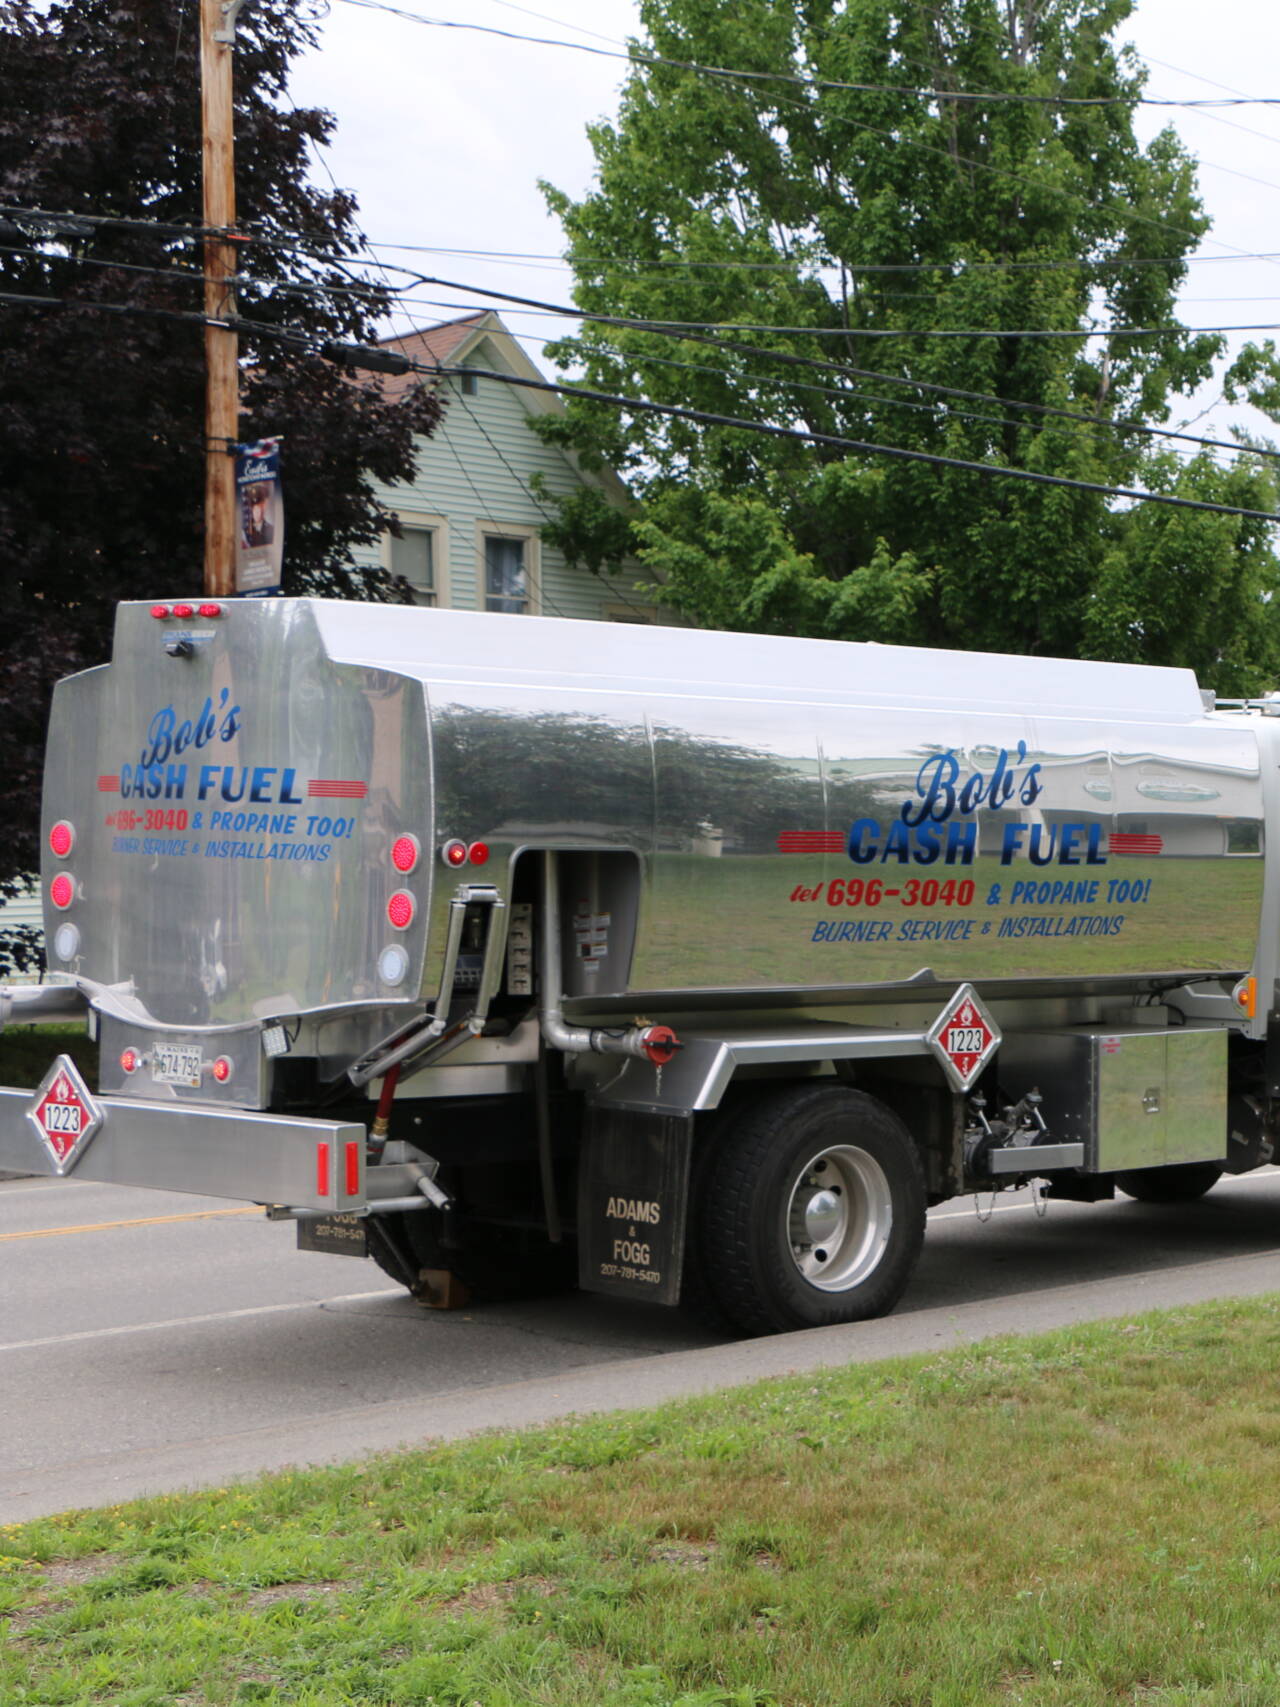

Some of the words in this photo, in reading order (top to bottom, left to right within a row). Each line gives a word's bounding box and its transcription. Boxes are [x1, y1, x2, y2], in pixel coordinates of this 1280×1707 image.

[142, 687, 241, 770] Bob's
[120, 763, 189, 800] CASH
[197, 766, 304, 805] FUEL
[902, 739, 1043, 828] Bob's
[191, 811, 203, 830] &
[210, 811, 297, 835] PROPANE
[306, 815, 356, 839] TOO!
[142, 837, 190, 857] SERVICE
[204, 840, 332, 862] INSTALLATIONS
[847, 818, 978, 866] CASH
[1000, 822, 1108, 866] FUEL
[789, 881, 824, 903] tel
[826, 878, 976, 907] 696-3040
[986, 883, 1001, 906] &
[1009, 880, 1099, 905] PROPANE
[1107, 878, 1152, 904] TOO!
[811, 920, 894, 943] BURNER
[896, 919, 977, 942] SERVICE
[981, 920, 992, 936] &
[997, 914, 1127, 938] INSTALLATIONS
[950, 1030, 981, 1052] 1223
[46, 1106, 80, 1131] 1223
[606, 1197, 661, 1224] ADAMS
[614, 1240, 651, 1265] FOGG
